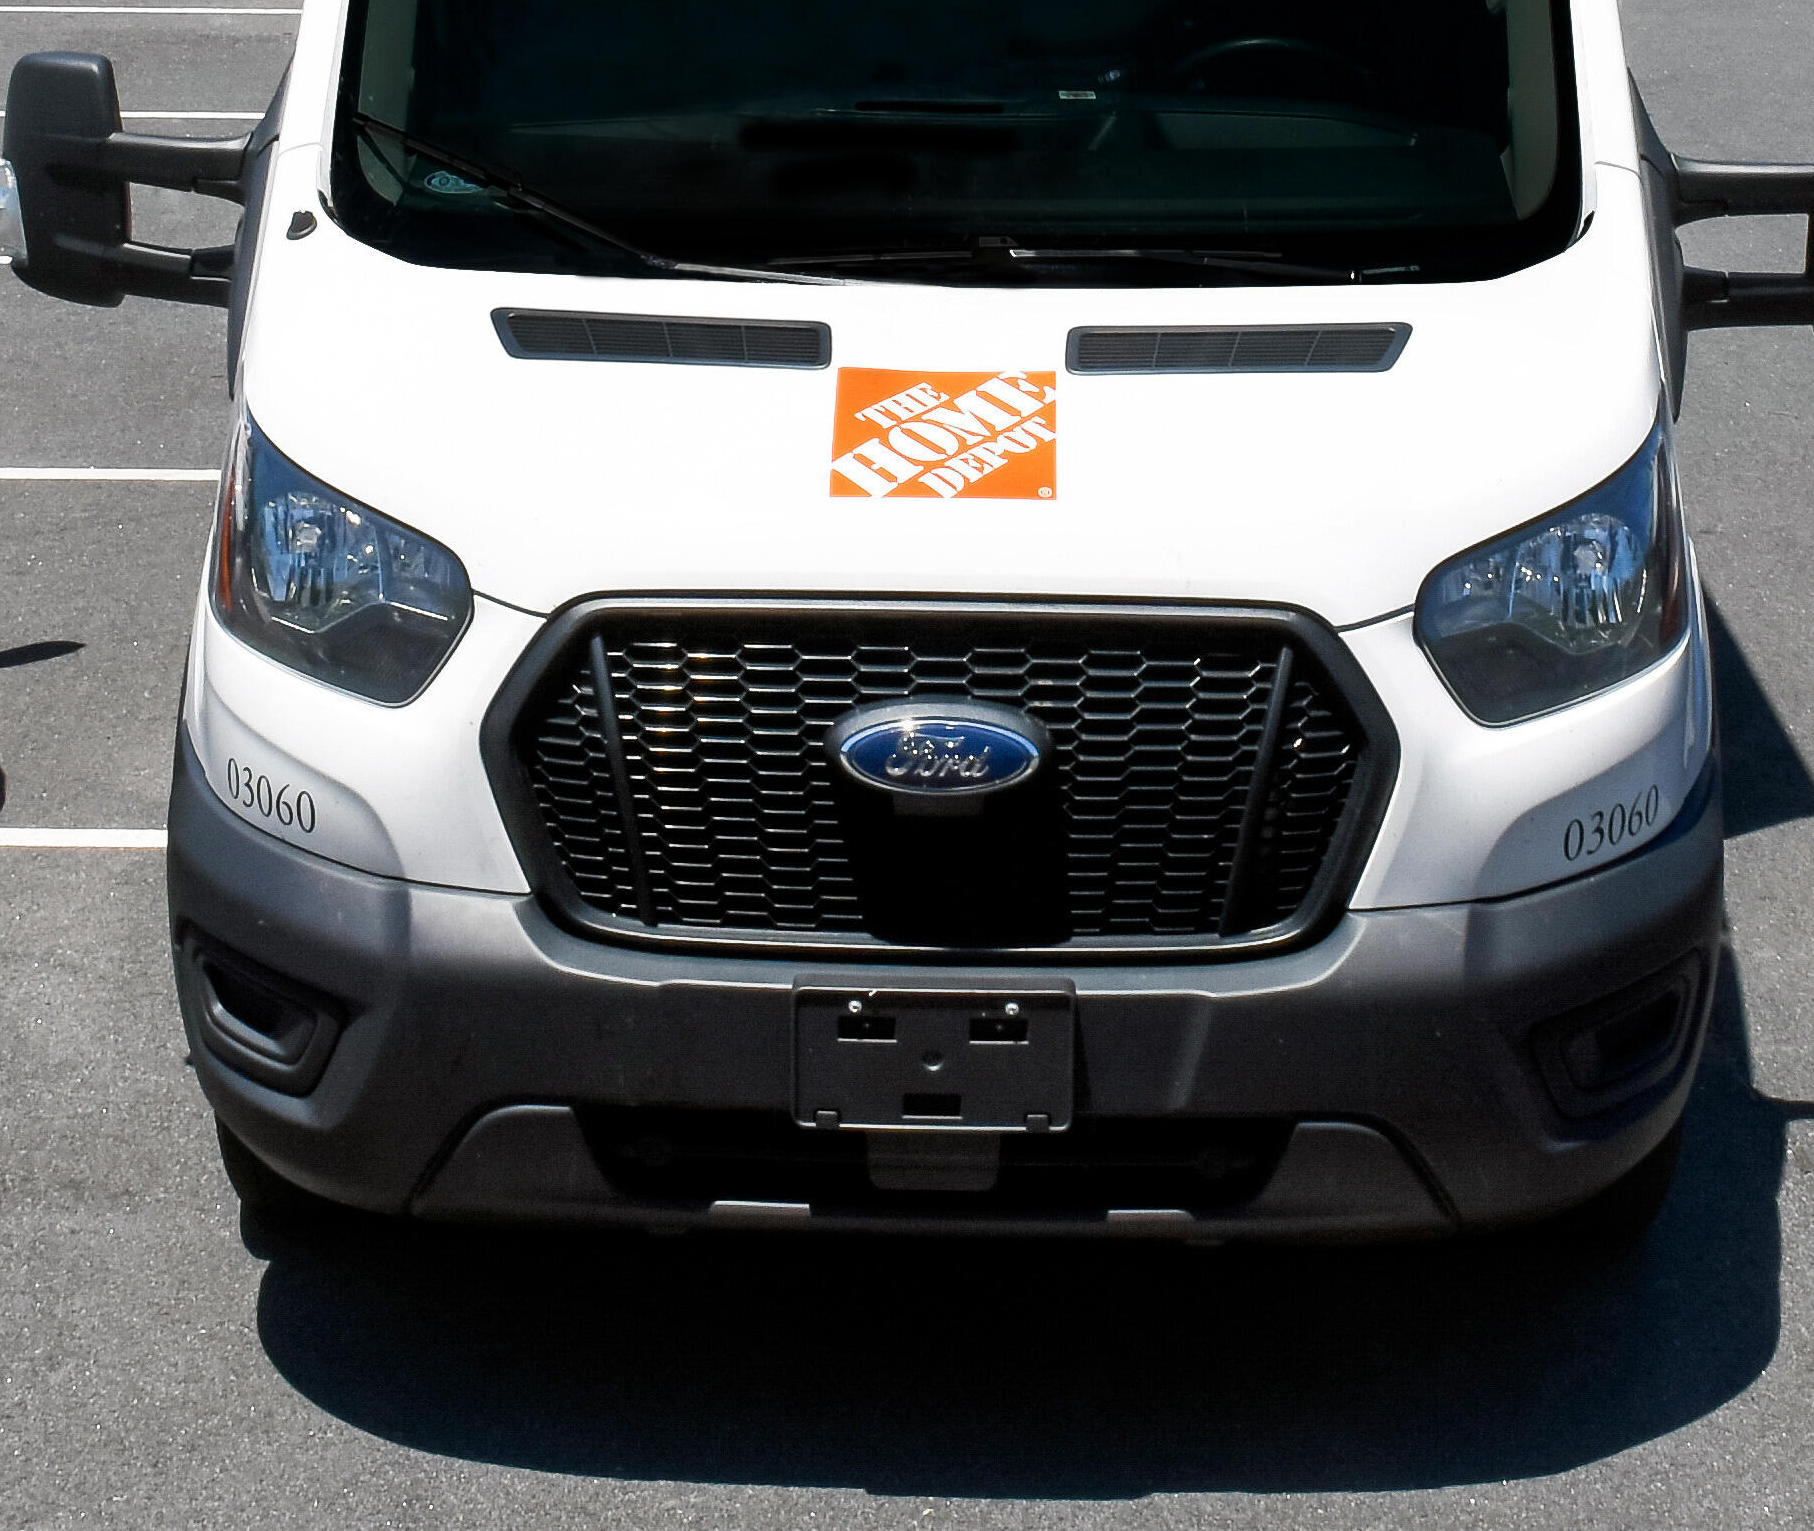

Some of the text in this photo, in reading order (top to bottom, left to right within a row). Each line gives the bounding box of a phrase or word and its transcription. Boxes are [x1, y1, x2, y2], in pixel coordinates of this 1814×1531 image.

[831, 370, 1056, 498] HOME
[854, 381, 951, 429] THE
[918, 415, 1056, 498] DEPOT
[886, 731, 990, 778] Ford
[227, 757, 316, 834] 03060
[1563, 783, 1659, 862] 03060
